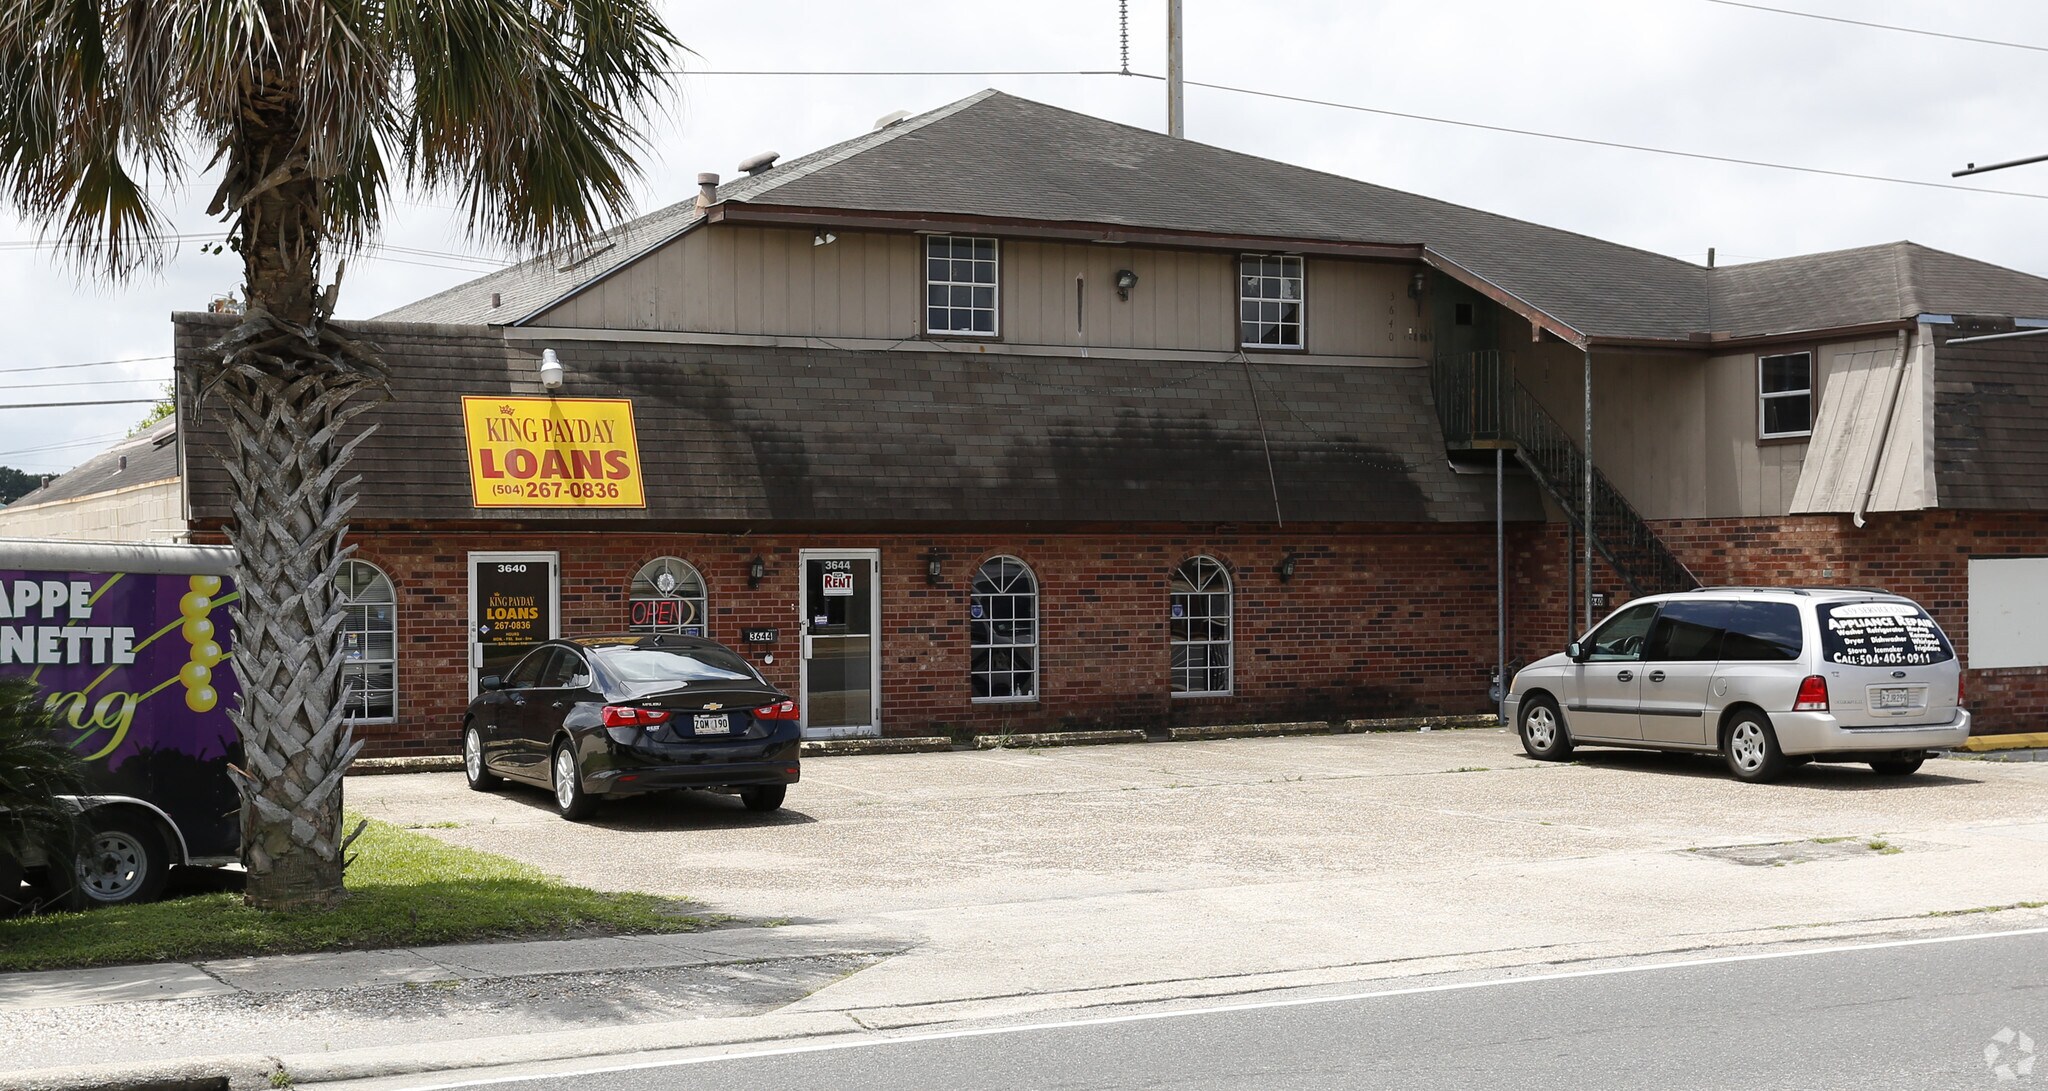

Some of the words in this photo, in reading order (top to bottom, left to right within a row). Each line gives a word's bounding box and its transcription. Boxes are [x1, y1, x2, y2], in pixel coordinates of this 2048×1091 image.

[486, 417, 538, 443] KING
[541, 418, 615, 443] PAYDAY
[479, 448, 631, 480] LOANS
[492, 484, 525, 497] (504)
[526, 481, 619, 498] 267-0836
[497, 564, 527, 573] 3640
[825, 560, 851, 570] 3644
[825, 575, 852, 588] RENT
[489, 596, 508, 607] KING
[508, 596, 535, 607] PAYDAY
[486, 607, 539, 620] LOANS
[632, 601, 684, 624] OPEN
[494, 621, 531, 630] 267-0836
[1828, 617, 1895, 630] APPLIANCE
[1893, 615, 1935, 628] REPAIR
[750, 632, 773, 641] 3644
[1836, 628, 1864, 636] Washer
[1843, 638, 1865, 646] Dryer
[1870, 635, 1907, 643] Dishwasher
[0, 626, 136, 664] NETTE
[714, 719, 728, 728] 190
